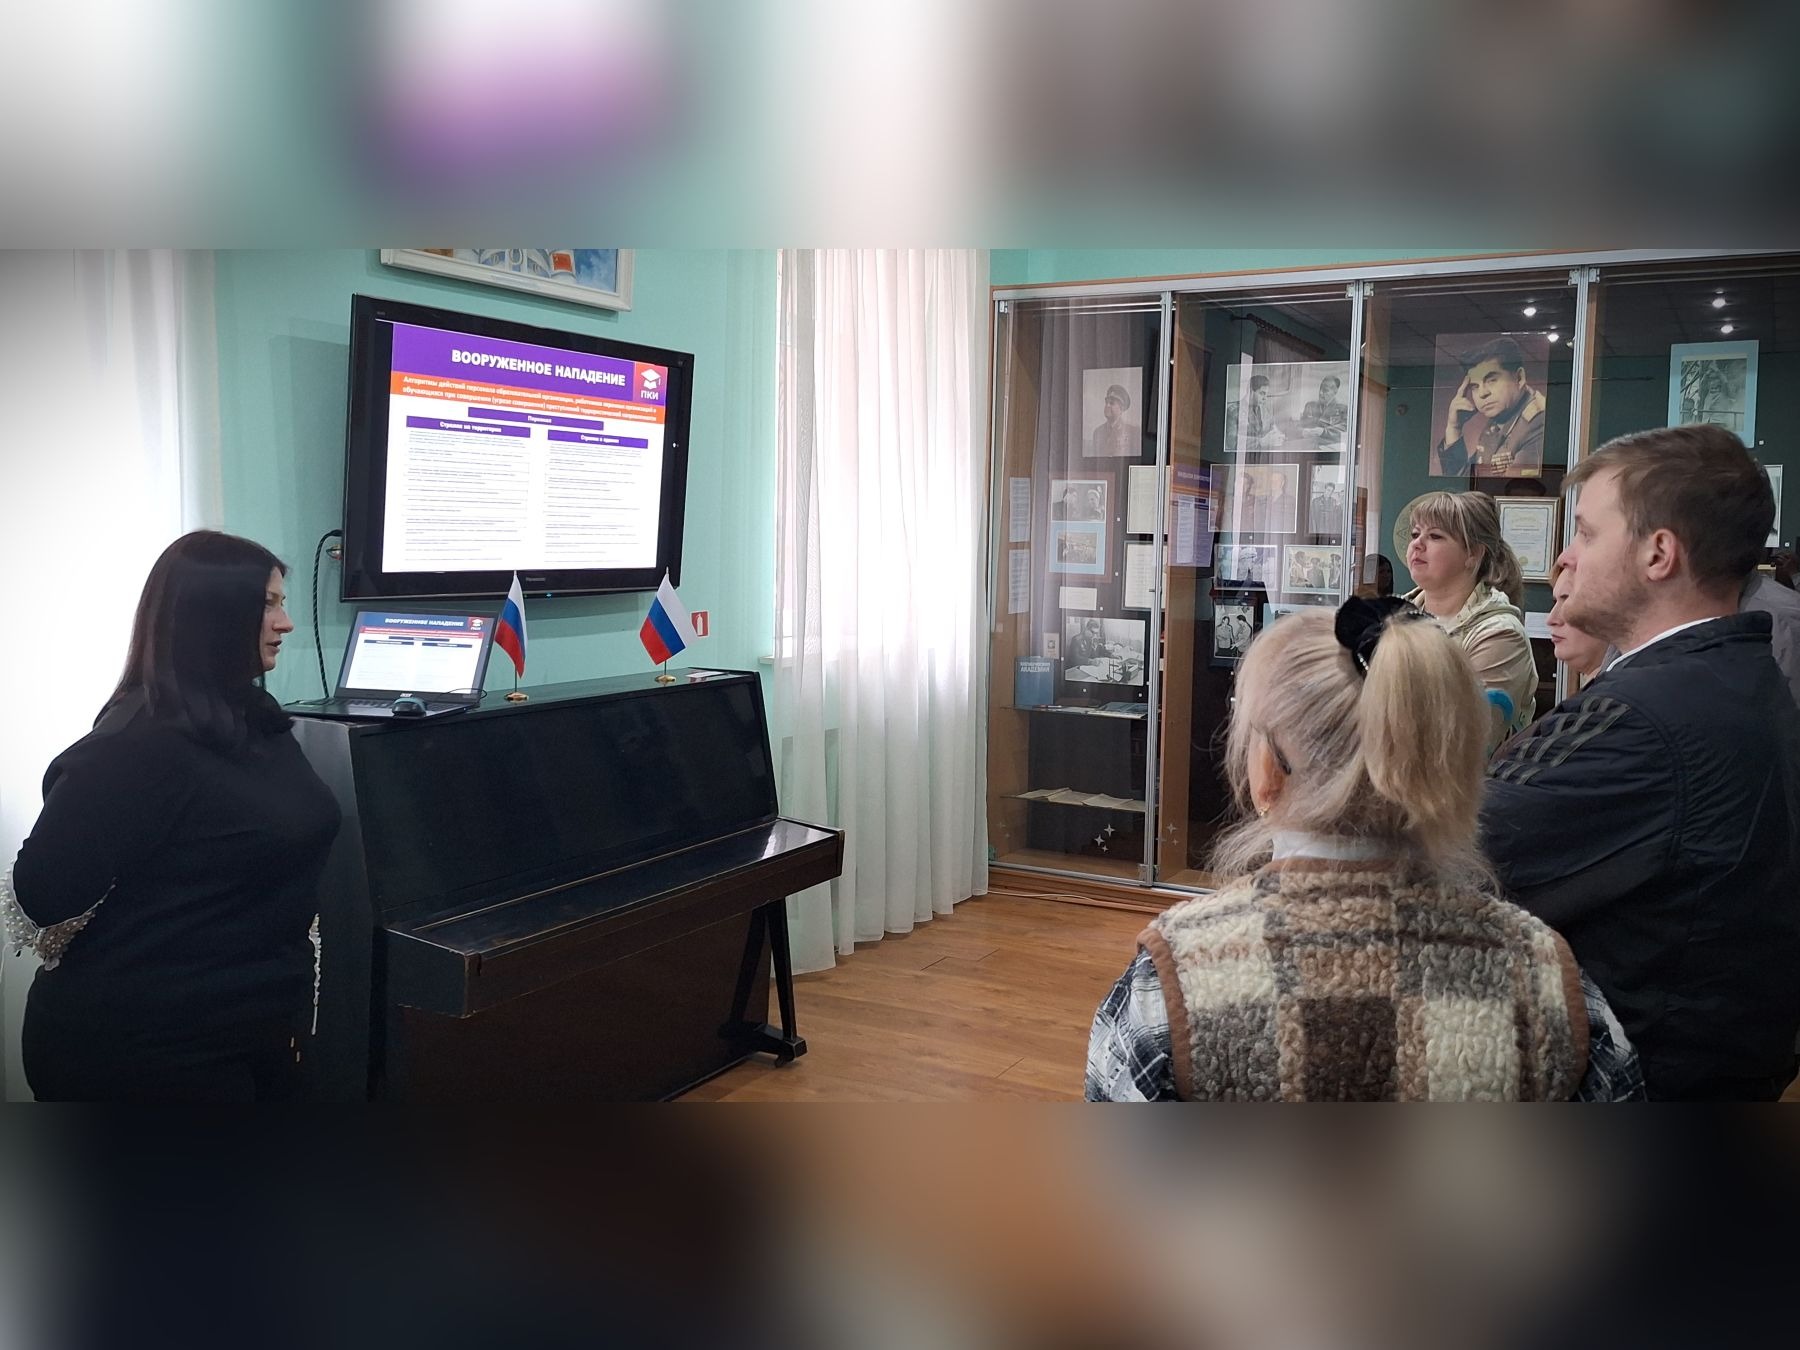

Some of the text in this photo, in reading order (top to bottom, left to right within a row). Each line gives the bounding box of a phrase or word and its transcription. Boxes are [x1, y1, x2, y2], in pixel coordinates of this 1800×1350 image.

[451, 349, 626, 386] ВООРУЖЕННОЕ НАПАДЕНИЕ
[640, 390, 659, 400] ПКИ
